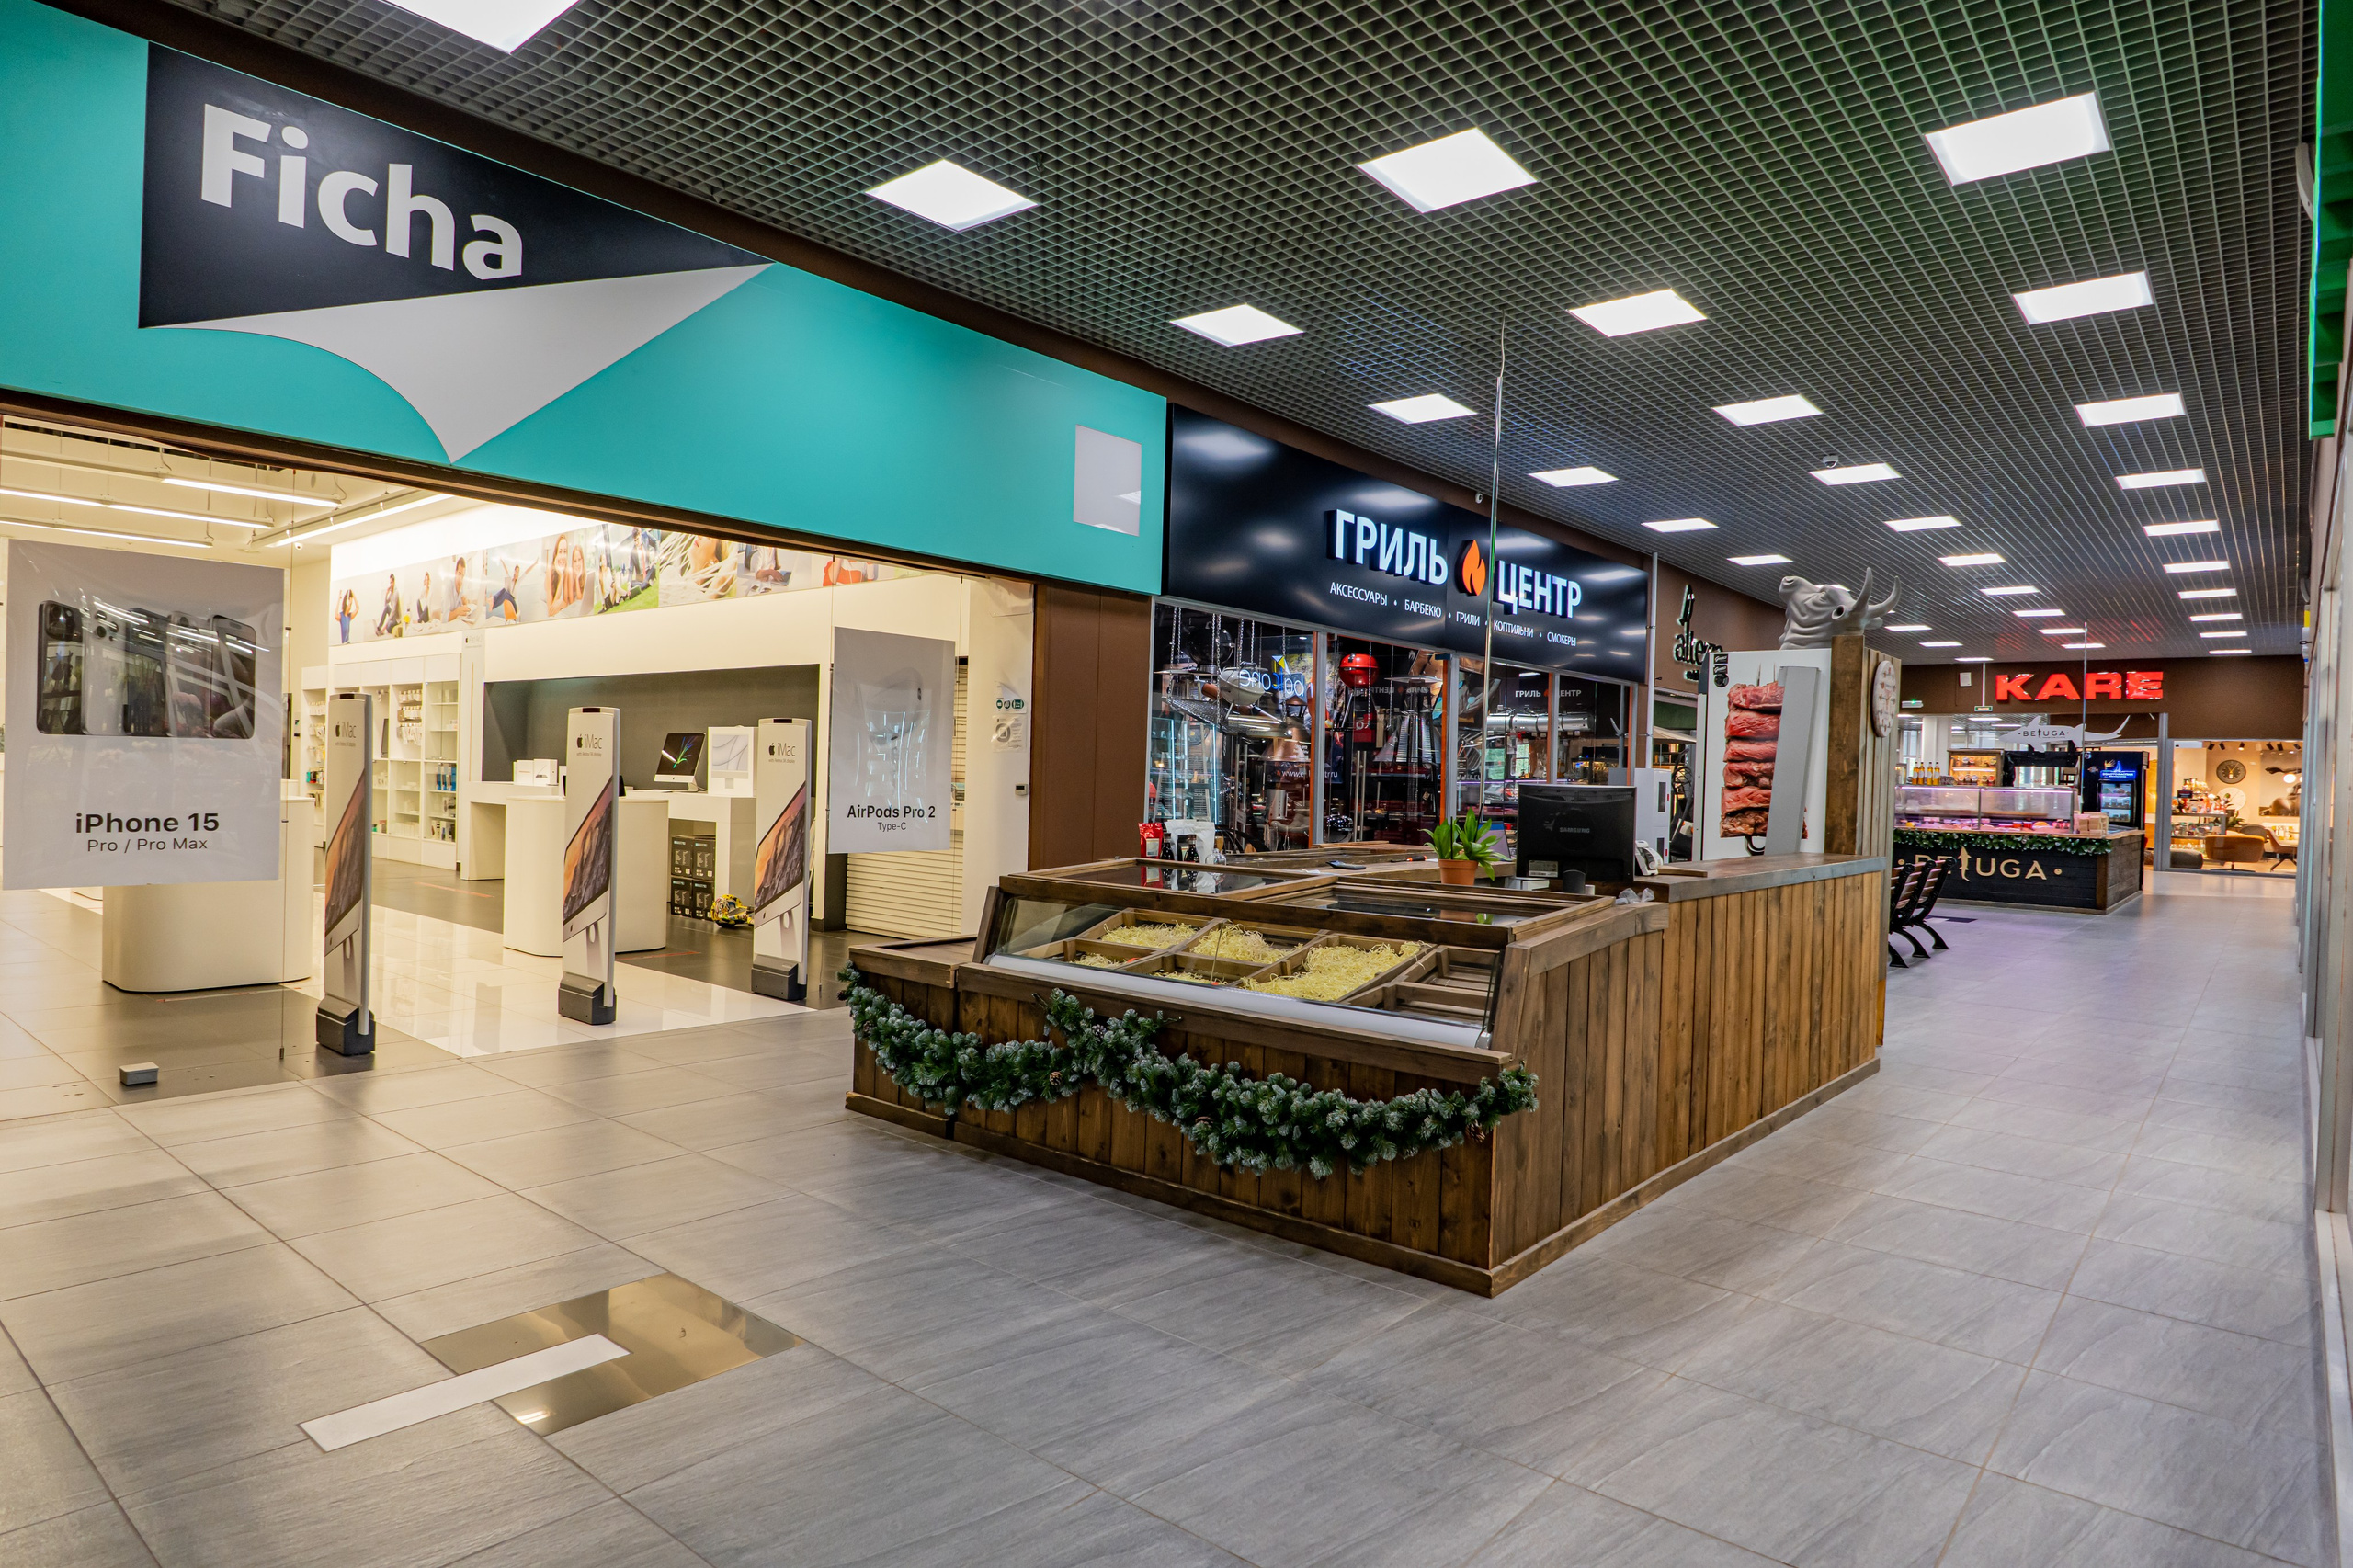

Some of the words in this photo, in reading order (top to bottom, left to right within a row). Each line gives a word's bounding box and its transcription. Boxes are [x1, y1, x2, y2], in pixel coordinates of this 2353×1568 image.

[201, 103, 523, 280] Ficha
[1335, 508, 1449, 585] ГРИЛЬ
[1496, 560, 1582, 619] ЦЕНТР
[1329, 582, 1388, 607] АКСЕССУАРЫ
[1404, 599, 1442, 619] БАРБЕКЮ
[1456, 611, 1481, 627] ГРИЛИ
[1493, 619, 1534, 638] КОПТИЛЬНИ
[1547, 631, 1577, 647] СМОКЕРЫ
[1559, 689, 1582, 698] ЕНТР
[1995, 671, 2164, 701] KARE
[584, 733, 603, 749] iMac
[777, 742, 796, 756] iMac
[847, 804, 900, 818] AirPods
[903, 805, 925, 818] Pro
[928, 805, 936, 818] 2
[75, 812, 179, 834] iPhone
[188, 812, 220, 832] 15
[877, 821, 907, 832] Type-C
[87, 839, 118, 852] Pro
[124, 839, 131, 854] /
[137, 838, 166, 851] Pro
[173, 837, 208, 850] Max
